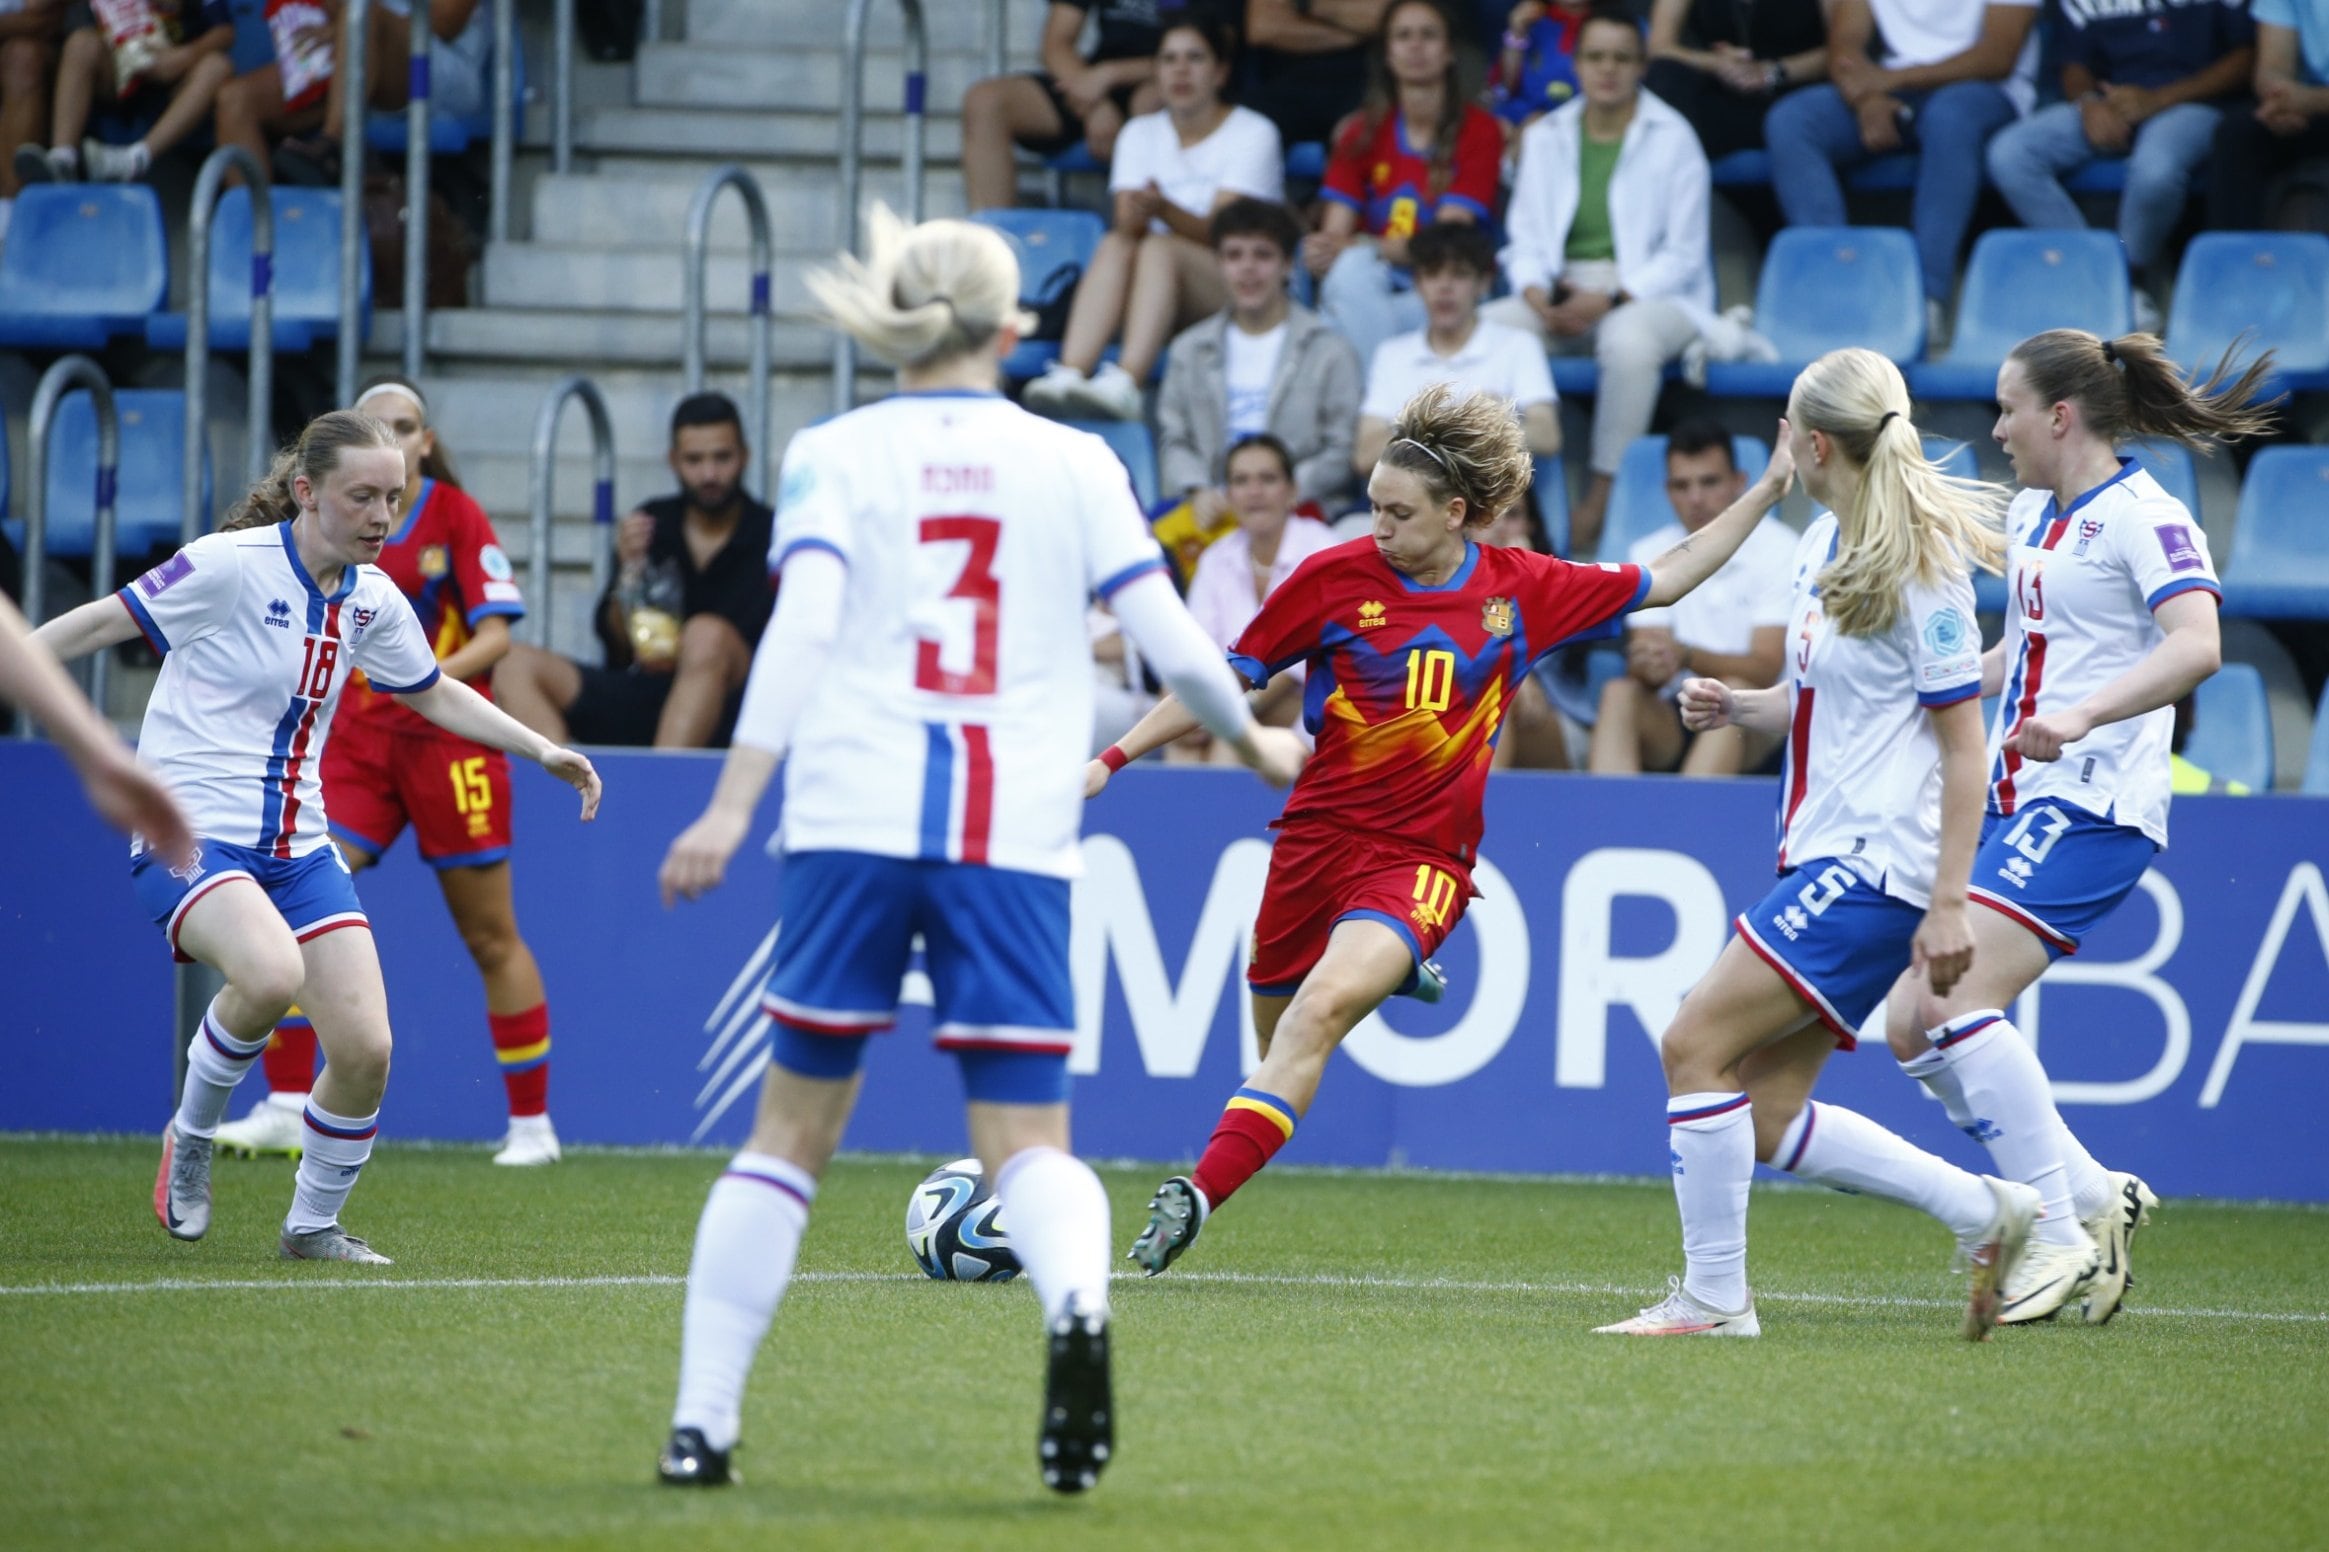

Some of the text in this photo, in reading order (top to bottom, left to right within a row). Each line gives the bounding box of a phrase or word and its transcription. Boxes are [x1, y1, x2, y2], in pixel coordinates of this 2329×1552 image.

[915, 516, 1002, 695] 3
[296, 636, 339, 700] 18
[1406, 648, 1455, 712] 10
[449, 756, 493, 814] 15
[2002, 804, 2073, 865] 13
[1411, 863, 1458, 927] 10
[1798, 864, 1858, 918] 5
